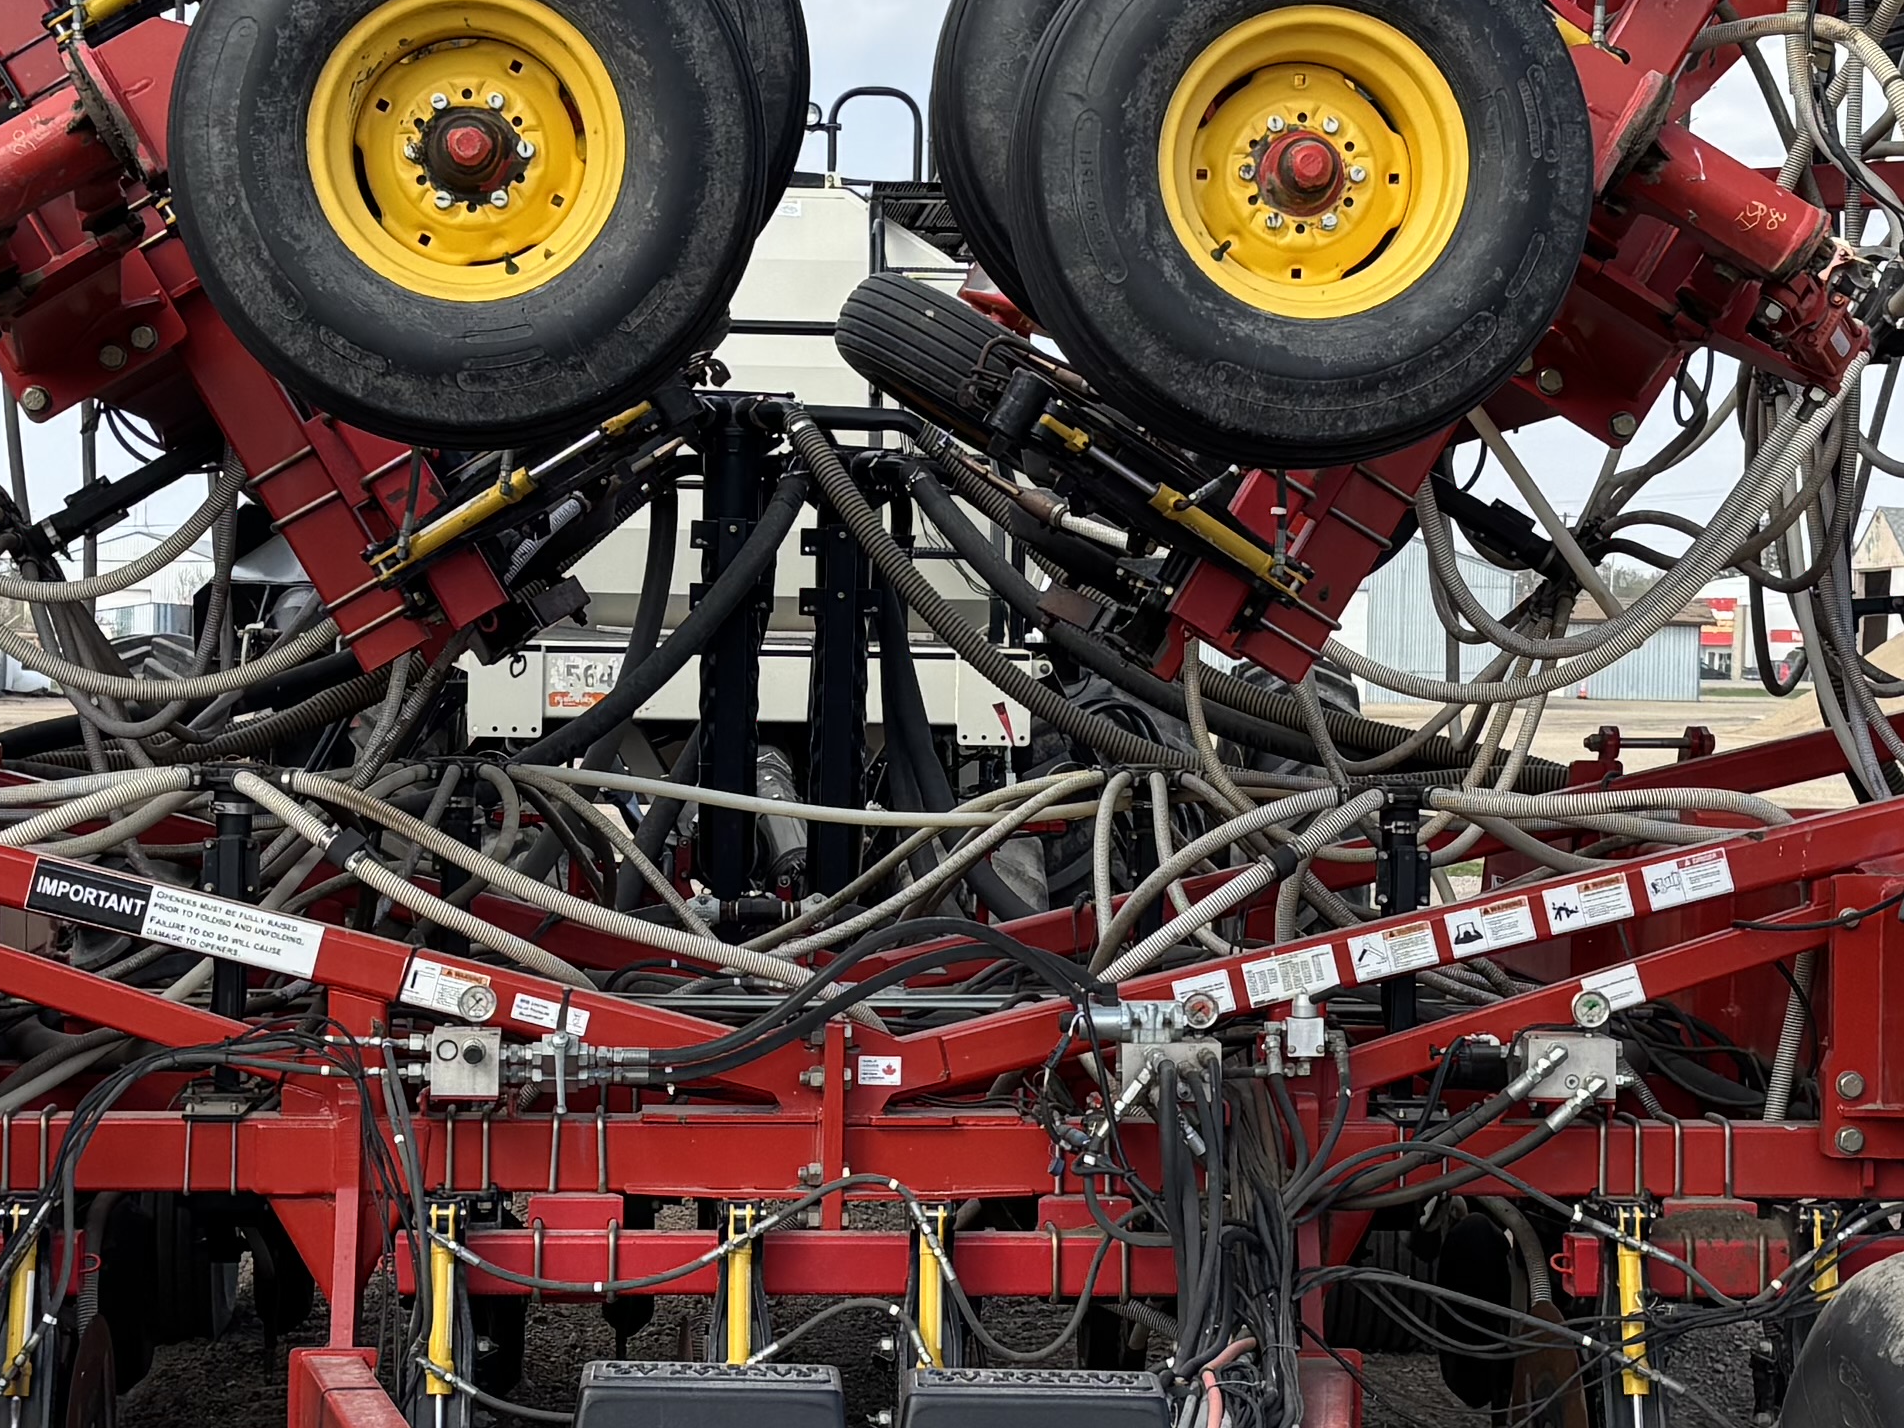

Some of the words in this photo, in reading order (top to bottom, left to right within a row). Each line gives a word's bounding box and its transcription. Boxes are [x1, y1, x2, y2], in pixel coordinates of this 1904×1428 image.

[36, 875, 145, 917] IMPORTANT
[157, 891, 196, 907] OPENERS
[200, 902, 222, 913] MUST
[226, 908, 236, 917] BE
[239, 911, 264, 924] FULLY
[153, 902, 179, 914] PRIOR
[183, 910, 193, 918] TO
[196, 913, 231, 927] FOLDING
[234, 923, 251, 933] AND
[147, 928, 182, 942] DAMAGE
[186, 938, 196, 946] TO
[199, 941, 240, 957] OPENERS.
[150, 916, 185, 932] FAILURE
[189, 926, 200, 935] TO
[202, 929, 214, 938] DO
[217, 933, 228, 942] SO
[232, 938, 250, 948] WILL
[253, 943, 282, 956] CAUSE
